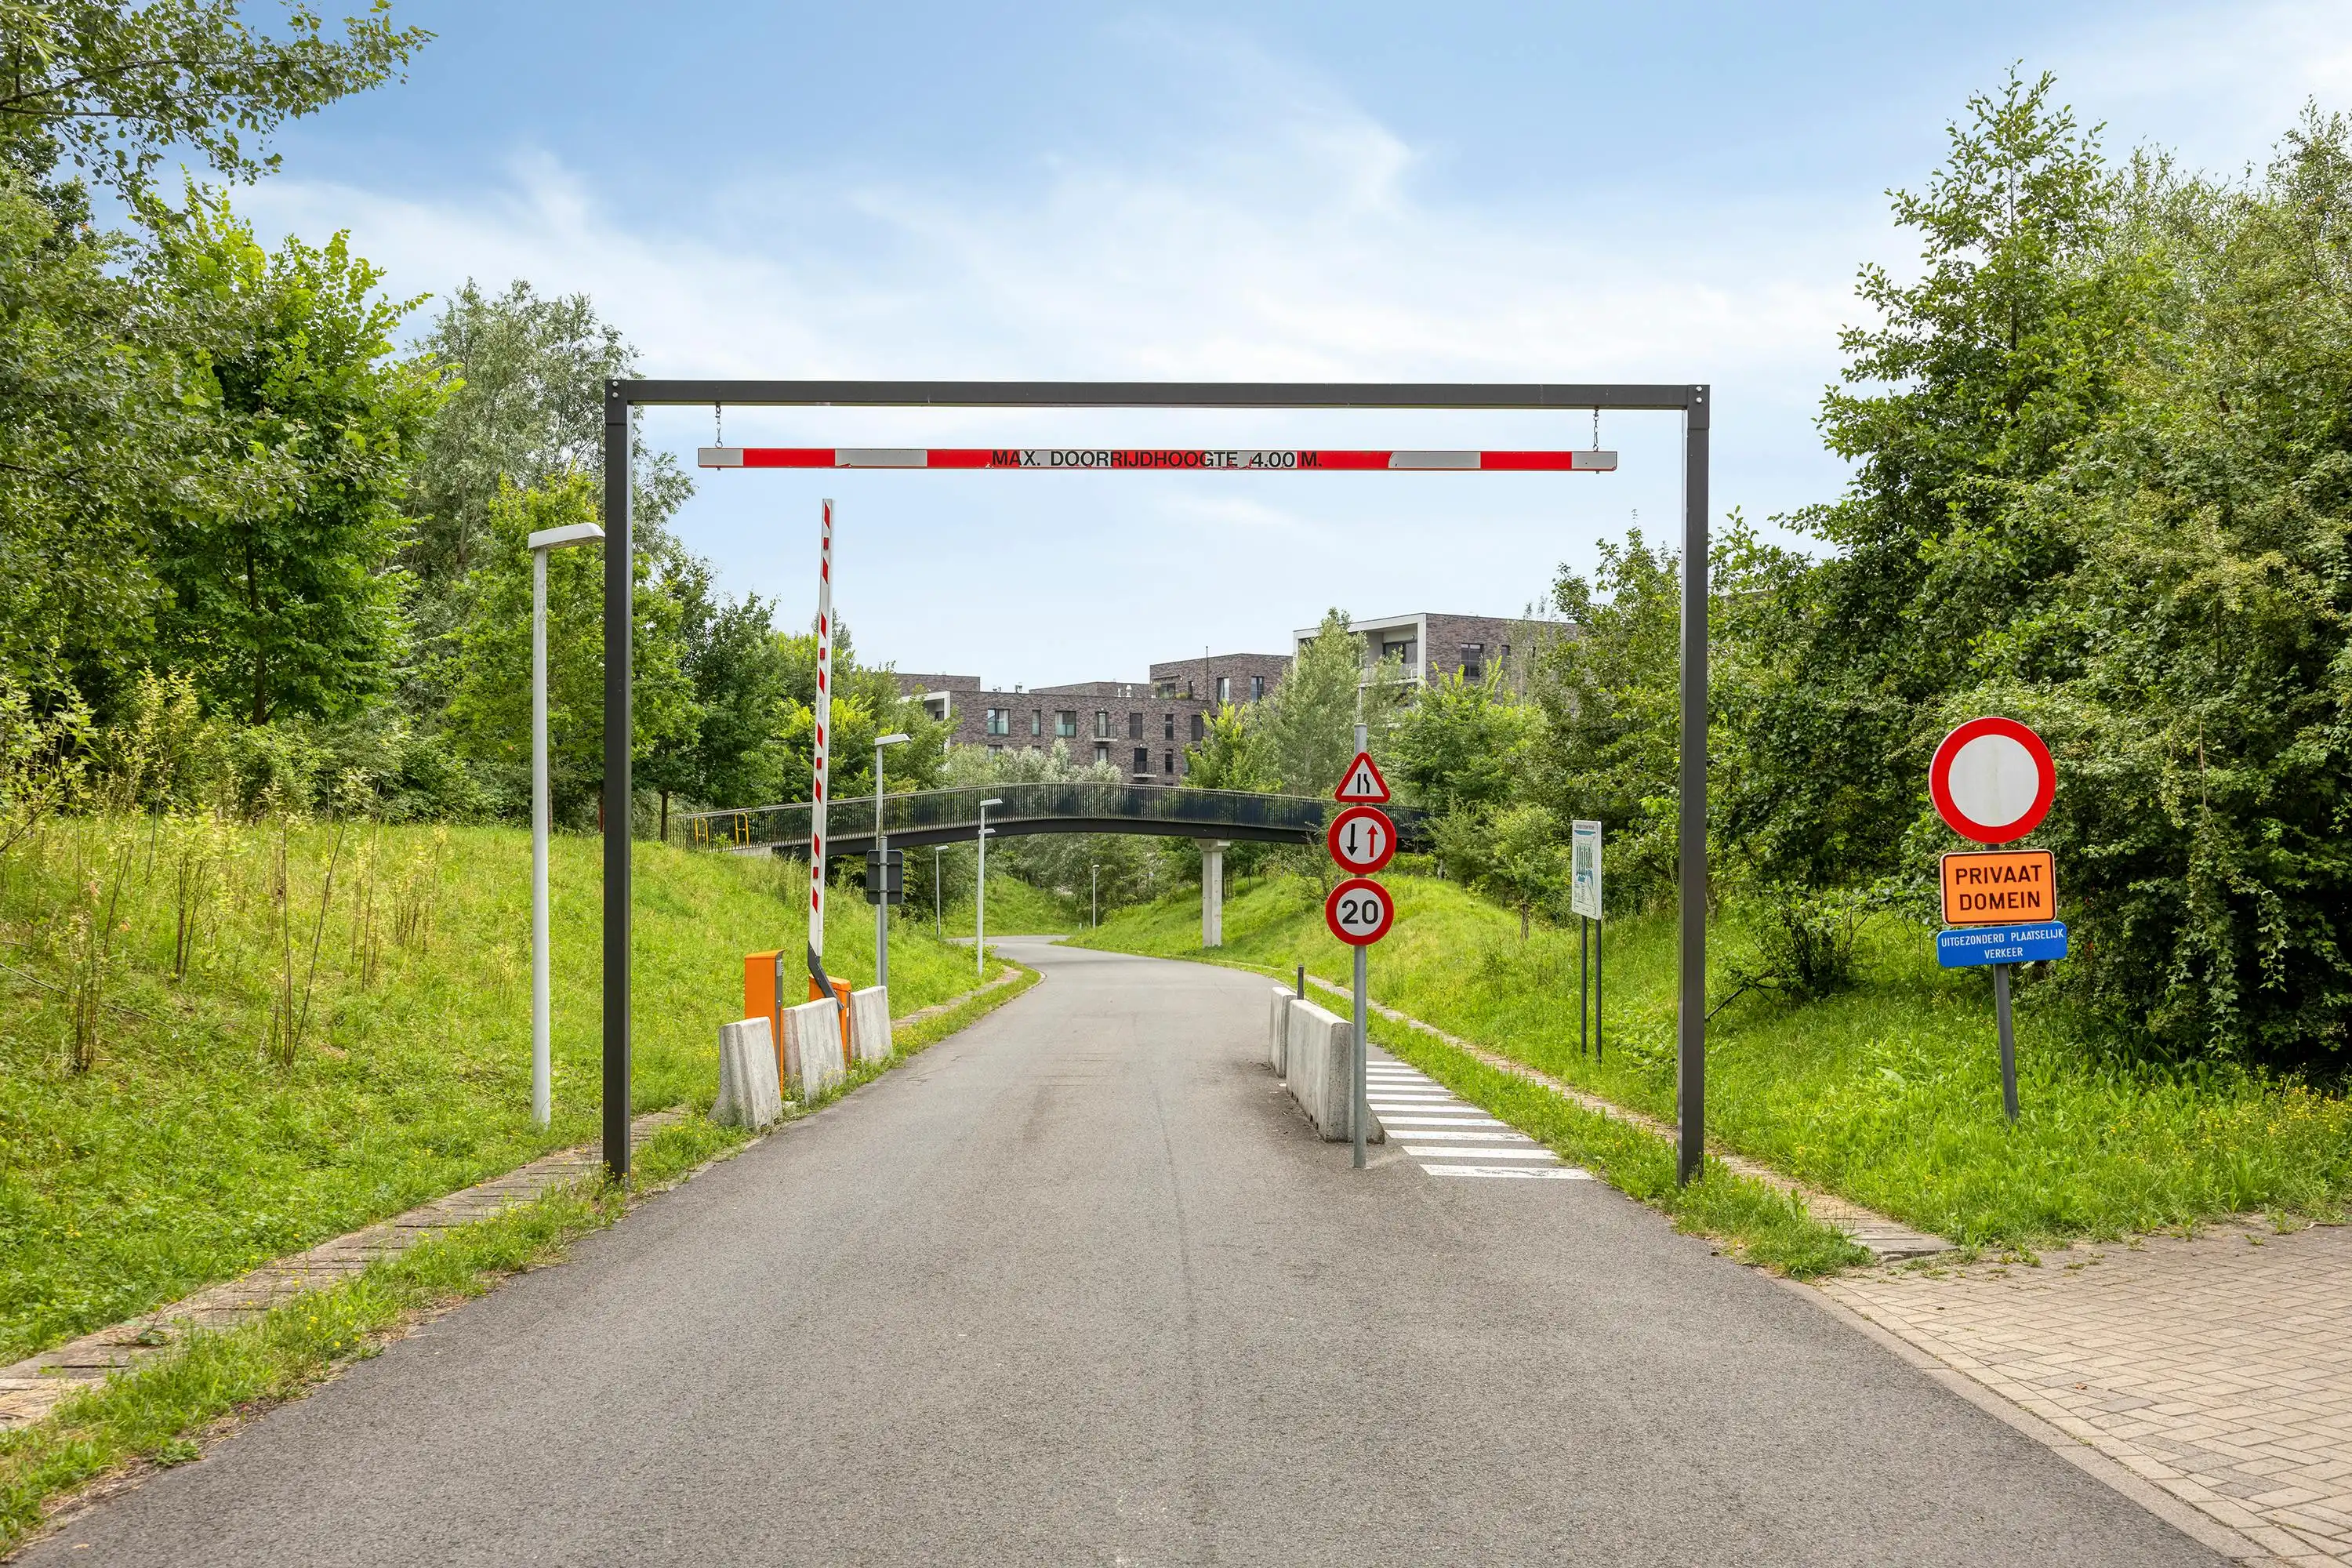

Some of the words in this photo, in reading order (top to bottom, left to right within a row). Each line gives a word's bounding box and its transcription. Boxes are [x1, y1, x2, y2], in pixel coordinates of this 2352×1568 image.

[992, 450, 1040, 466] MAX.
[1050, 451, 1238, 467] DOORRIJDHOOGTE
[1251, 451, 1295, 468] 4.00
[1301, 451, 1323, 467] M.
[1955, 865, 2042, 885] PRIVAAT
[1959, 891, 2041, 911] DOMEIN
[1341, 899, 1378, 924] 20
[1941, 933, 2005, 947] UITGEZONDERD
[2010, 928, 2064, 942] PLAATSELIJK
[1984, 946, 2024, 960] VERKEER
